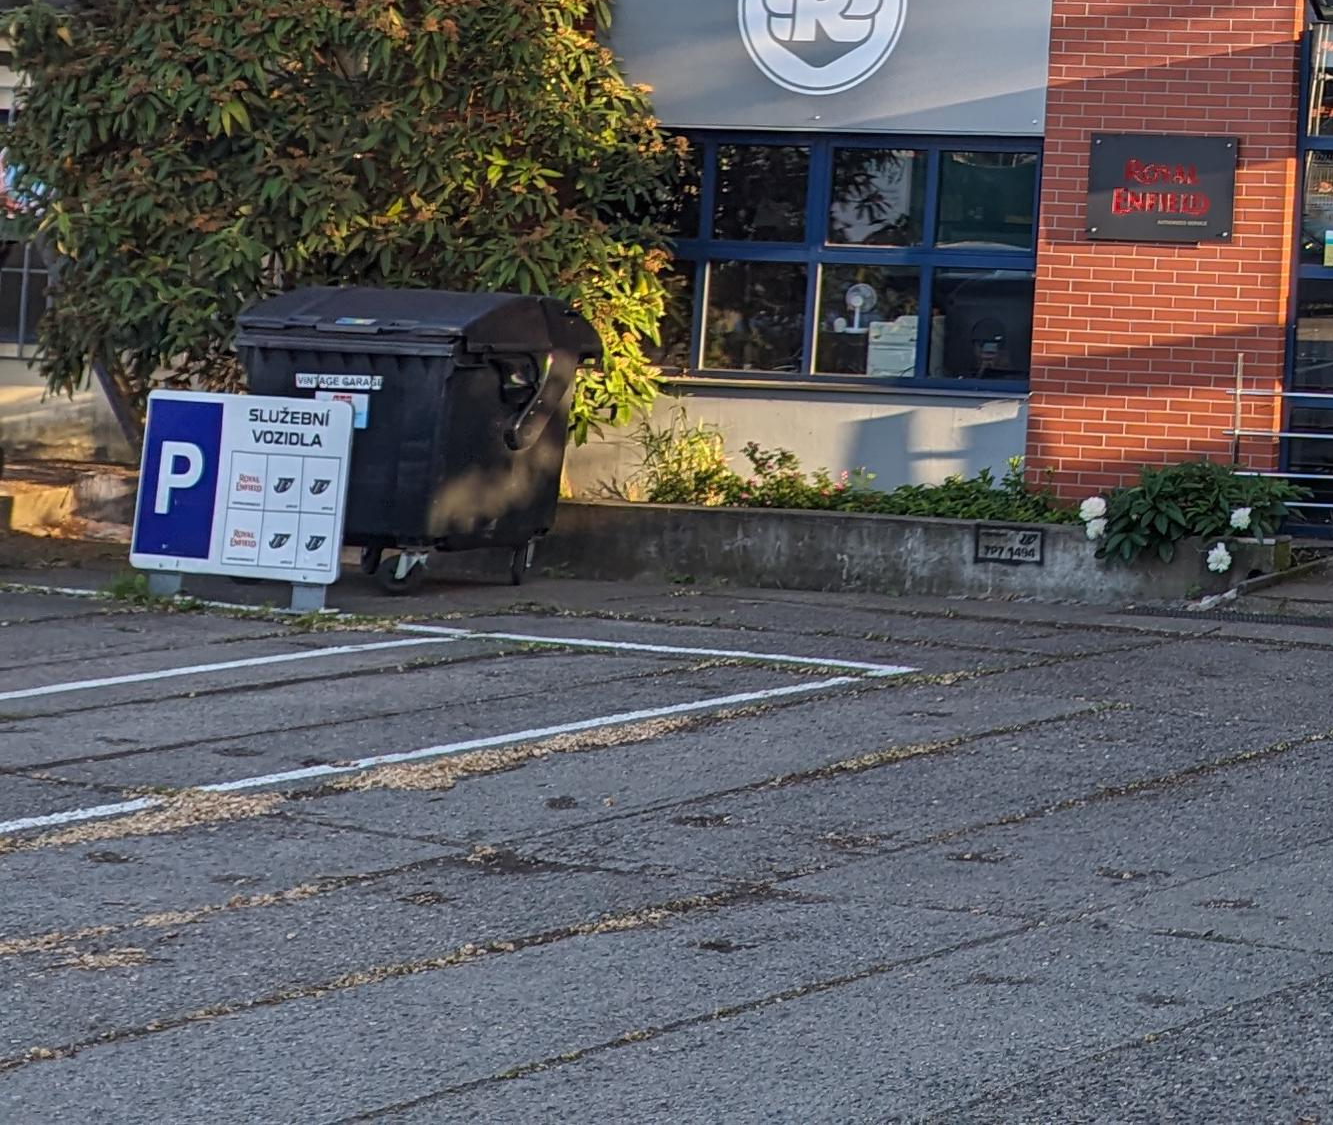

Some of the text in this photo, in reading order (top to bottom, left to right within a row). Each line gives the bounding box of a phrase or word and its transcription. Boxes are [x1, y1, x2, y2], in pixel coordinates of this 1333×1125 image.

[1124, 157, 1199, 185] ROYAL
[1111, 186, 1211, 217] ENFIELD
[298, 376, 340, 386] VINTAGE
[249, 406, 332, 427] SLUŽEBNÍ
[252, 429, 323, 448] VOZIDLA
[154, 440, 205, 515] P
